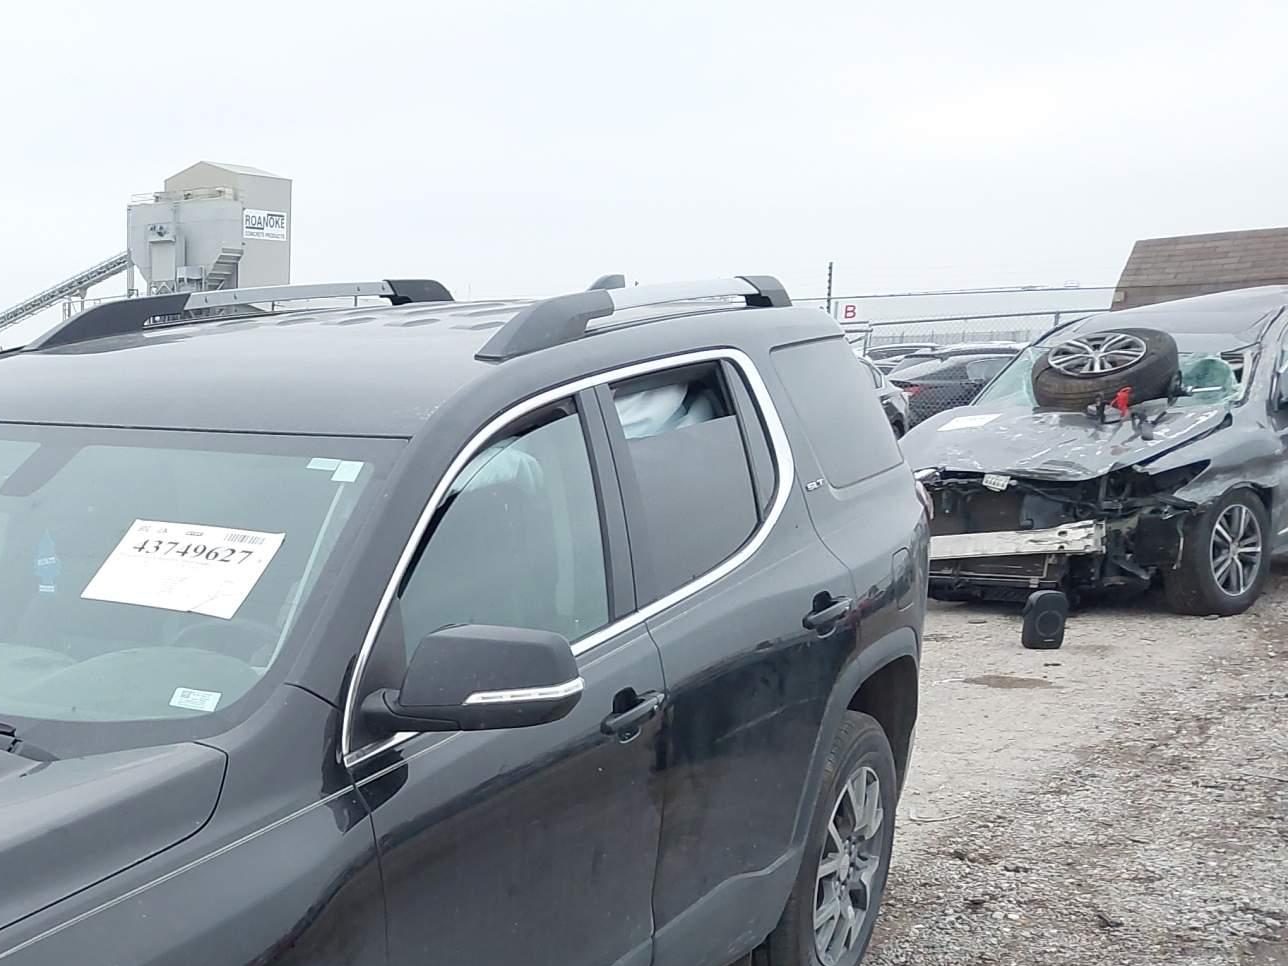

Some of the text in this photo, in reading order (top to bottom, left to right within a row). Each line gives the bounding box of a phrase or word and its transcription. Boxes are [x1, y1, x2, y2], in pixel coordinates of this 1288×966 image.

[245, 214, 285, 229] ROANOKE
[844, 304, 857, 319] B
[806, 478, 824, 491] SLT
[133, 539, 253, 565] 43749627
